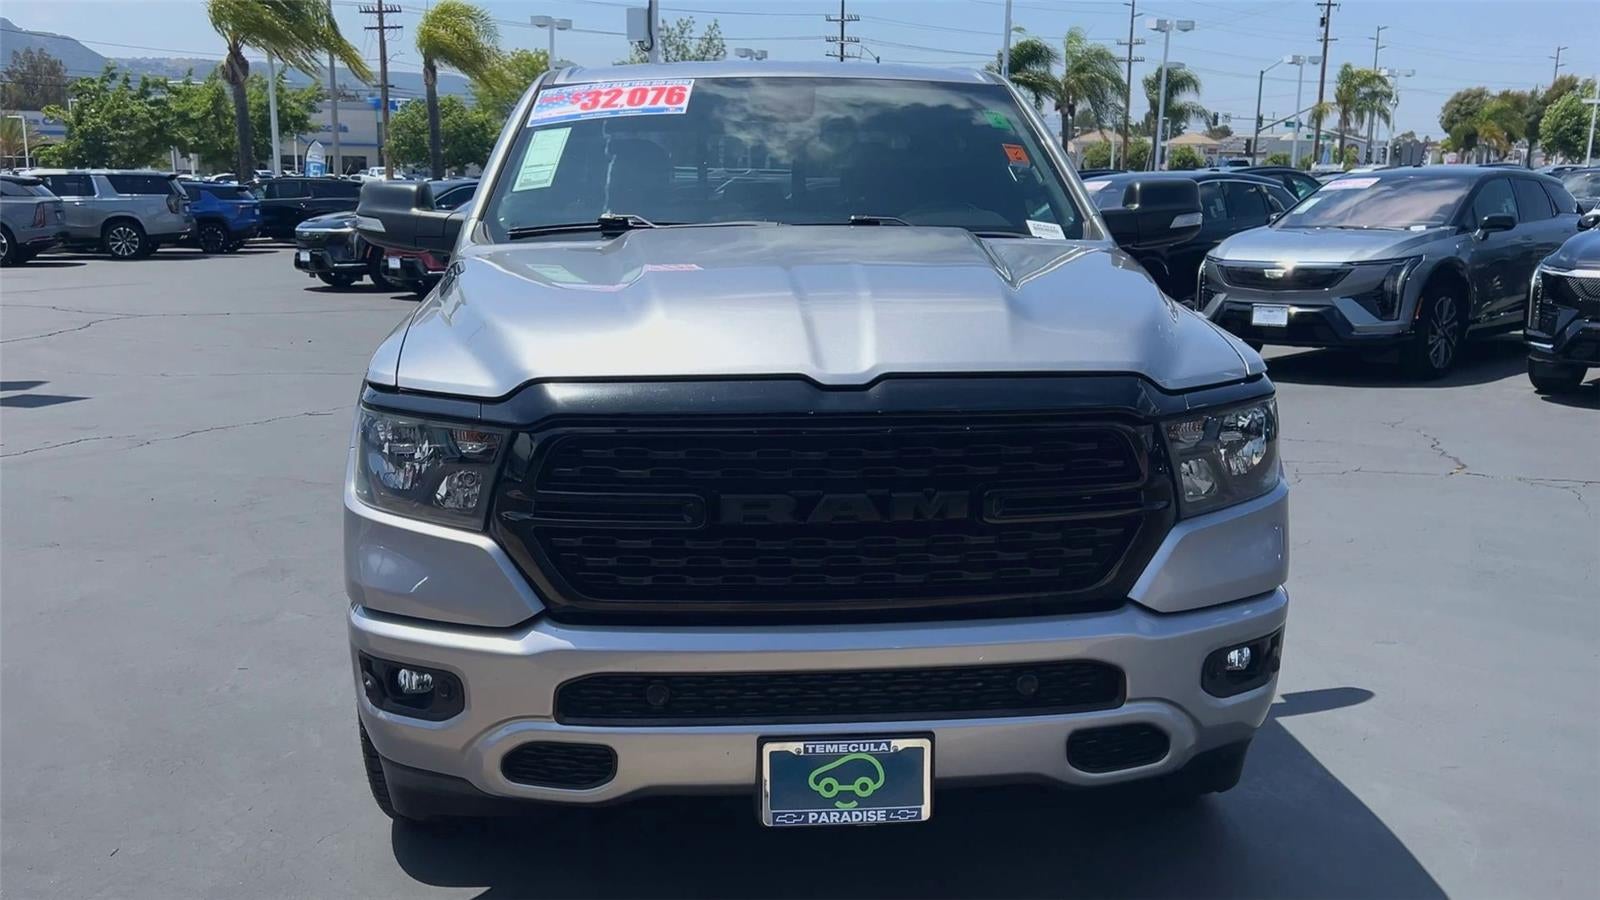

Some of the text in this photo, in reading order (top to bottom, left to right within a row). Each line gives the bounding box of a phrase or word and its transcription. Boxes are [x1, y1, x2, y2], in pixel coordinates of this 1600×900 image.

[570, 86, 688, 111] $32,076
[719, 488, 970, 525] RAM
[805, 742, 889, 754] TEMECULA
[808, 810, 887, 824] PARADISE
